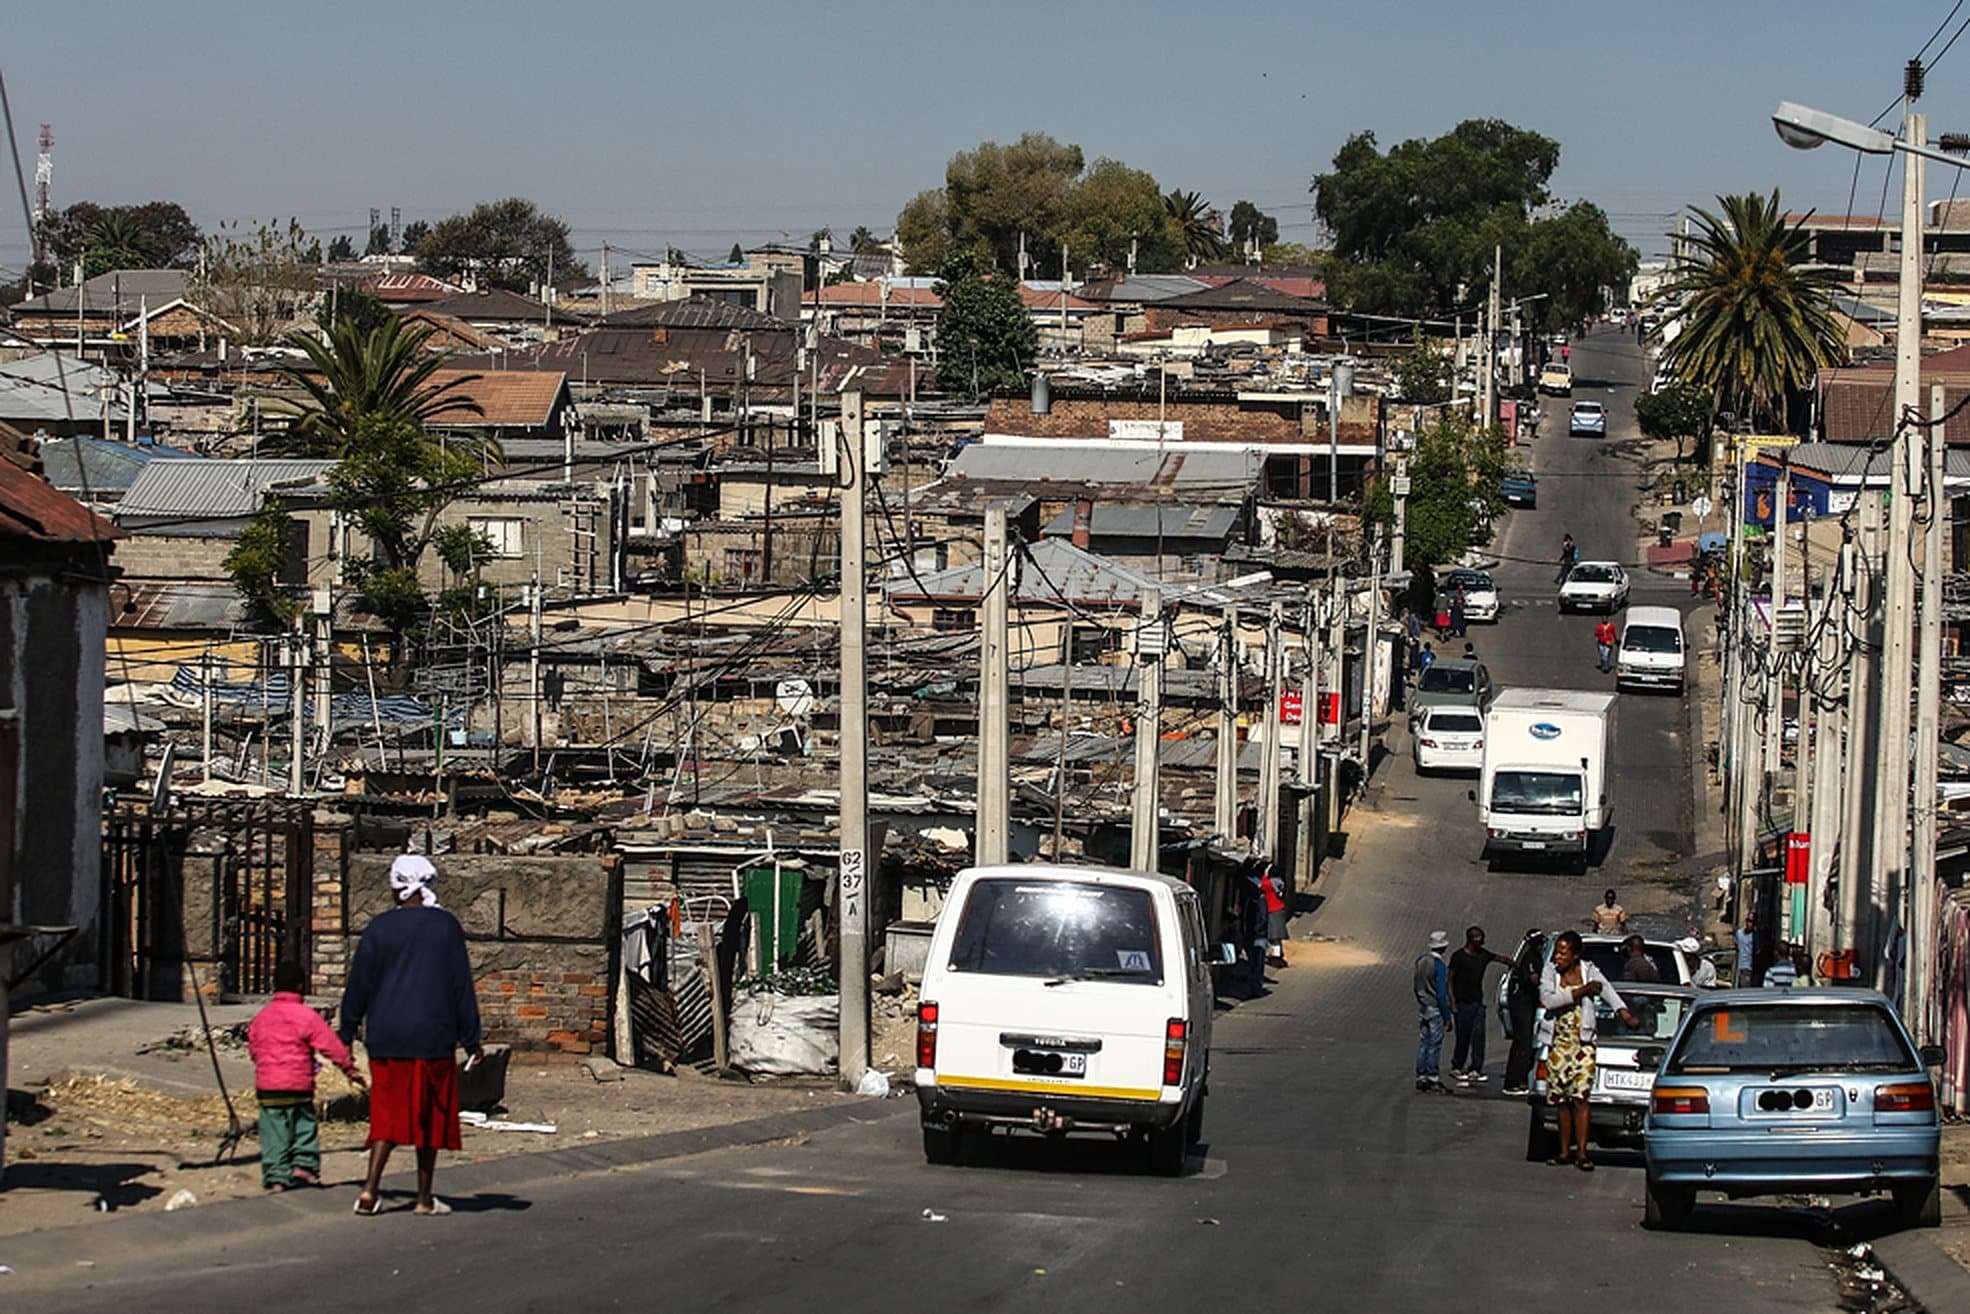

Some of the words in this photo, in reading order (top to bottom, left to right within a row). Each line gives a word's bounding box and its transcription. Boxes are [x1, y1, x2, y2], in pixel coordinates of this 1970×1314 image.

[1284, 701, 1302, 710] Gen
[1716, 1012, 1744, 1040] L
[1069, 1056, 1084, 1070] GP
